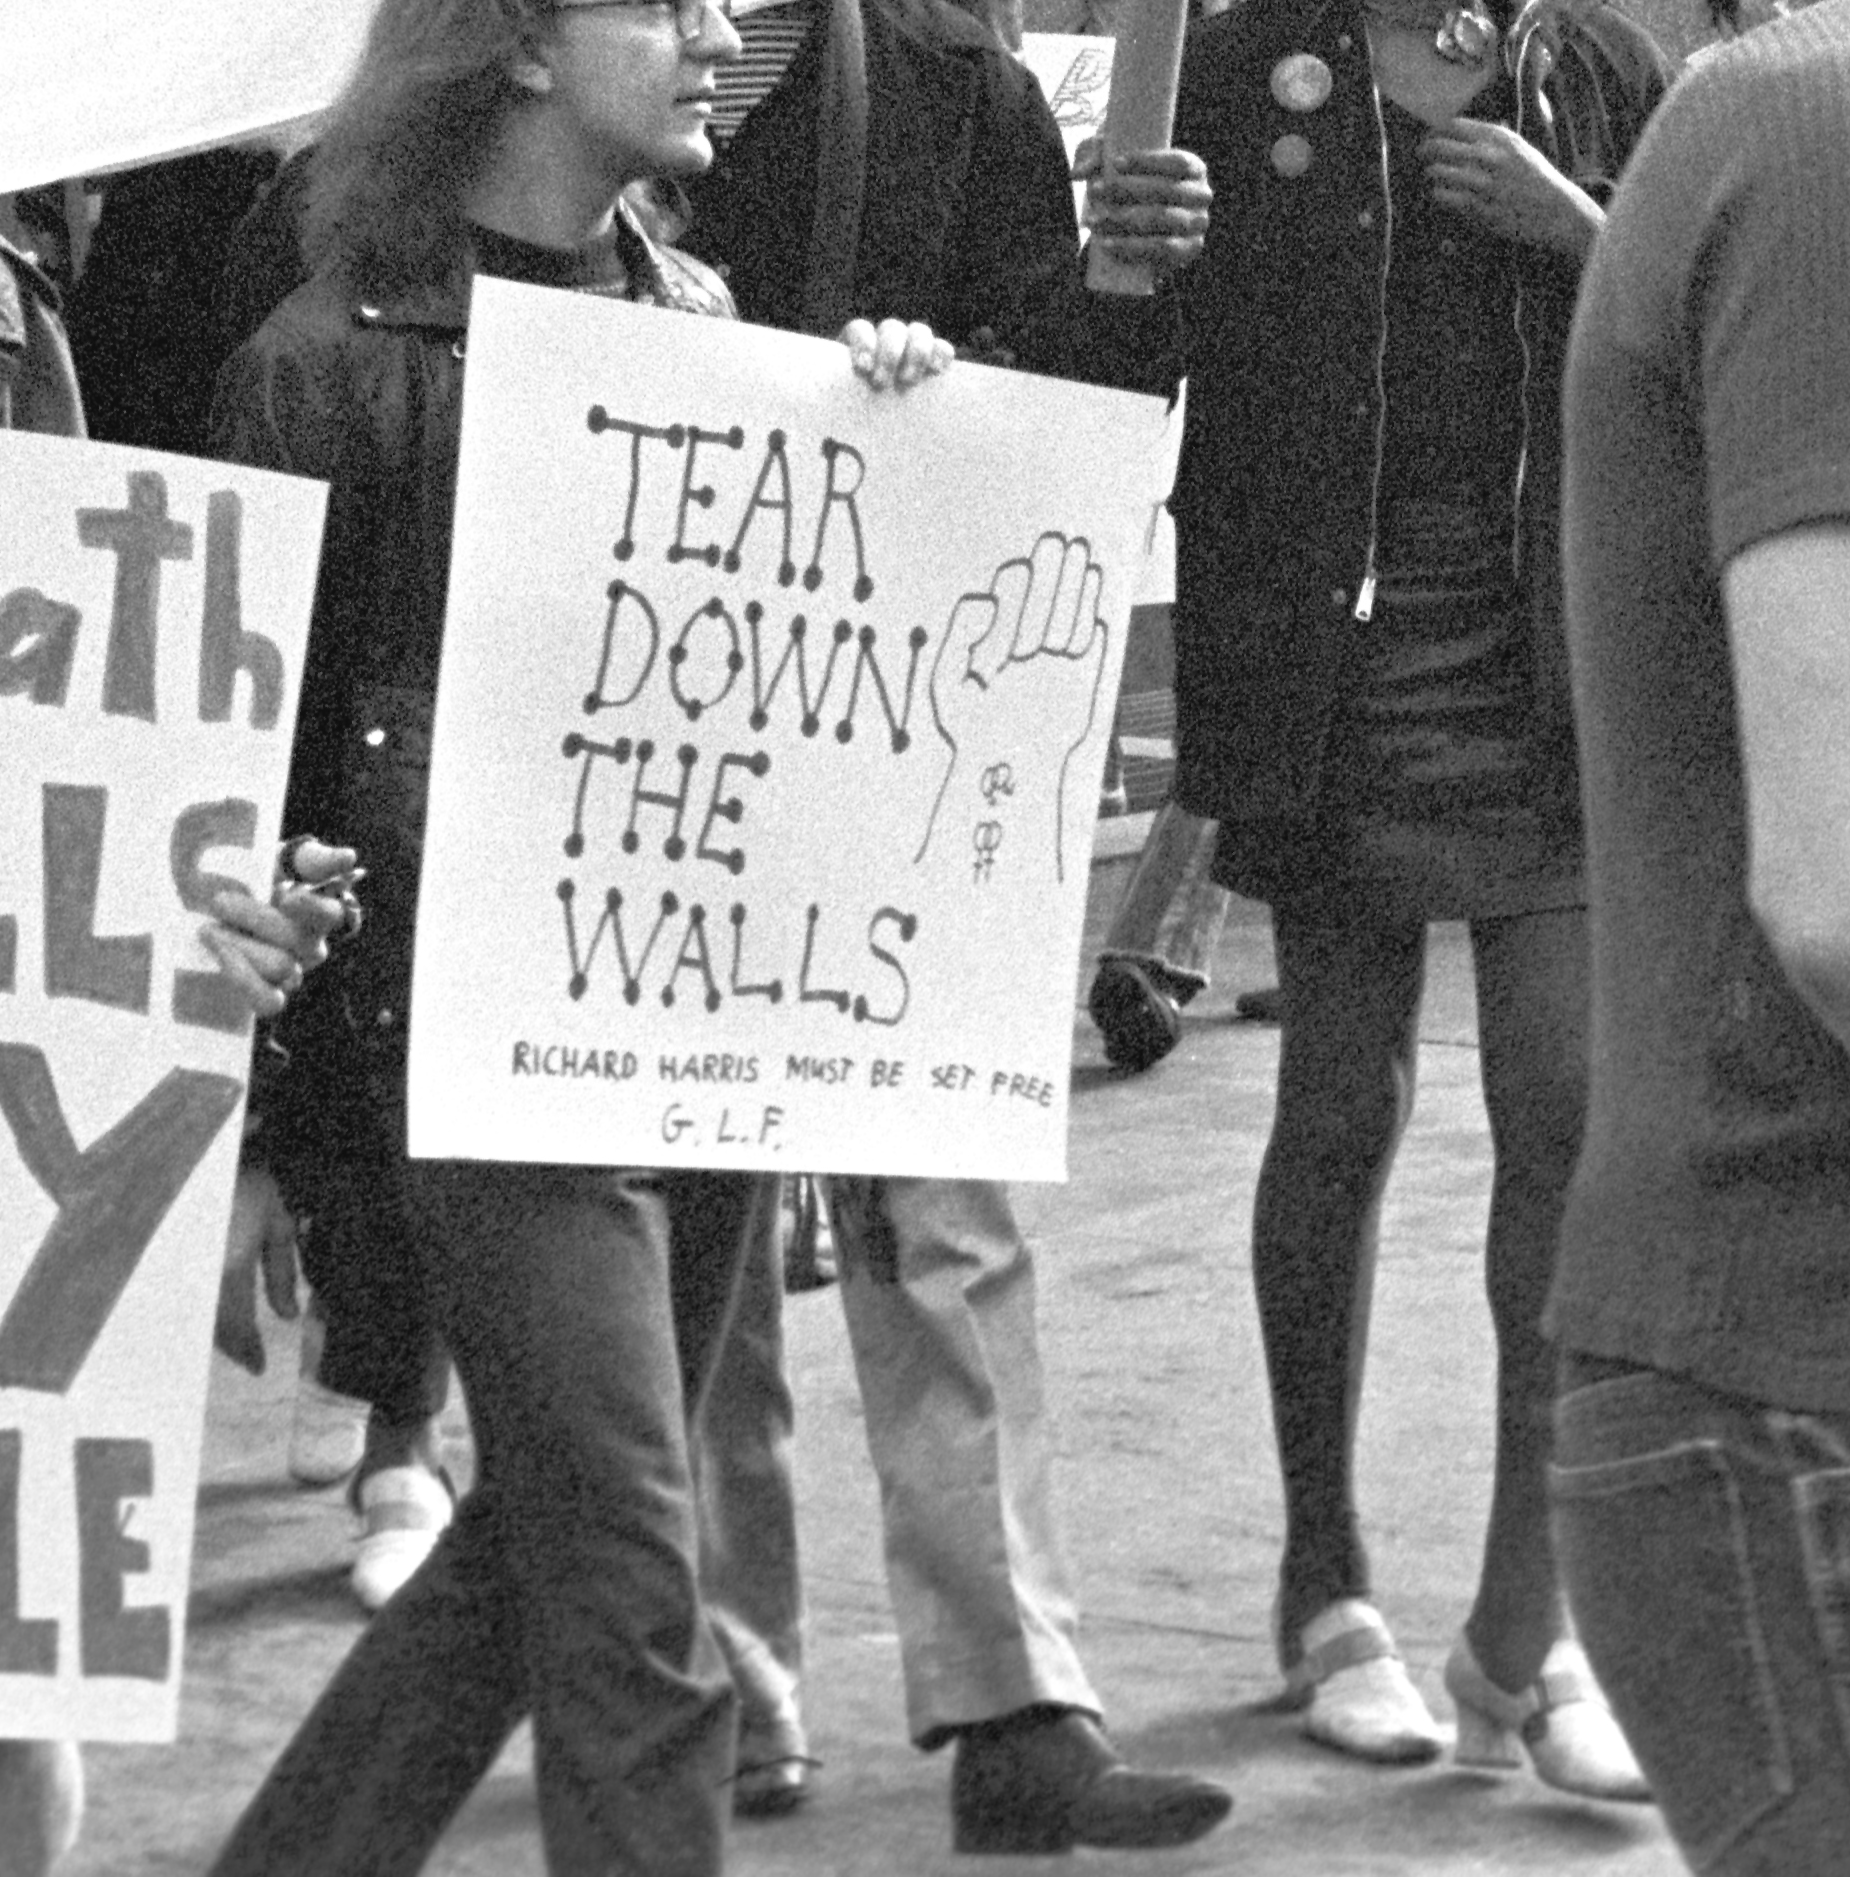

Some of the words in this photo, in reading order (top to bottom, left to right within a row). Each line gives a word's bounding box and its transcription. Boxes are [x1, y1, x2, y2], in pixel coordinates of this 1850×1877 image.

[586, 404, 875, 603] TEAR
[582, 578, 929, 753] DOWN
[562, 732, 771, 874] THE
[556, 878, 918, 1028] WALLS
[510, 1039, 639, 1081] RICHARD
[657, 1053, 760, 1084] HARRIS
[869, 1058, 905, 1089] BE
[929, 1062, 976, 1092] SET
[989, 1069, 1055, 1108] FREE
